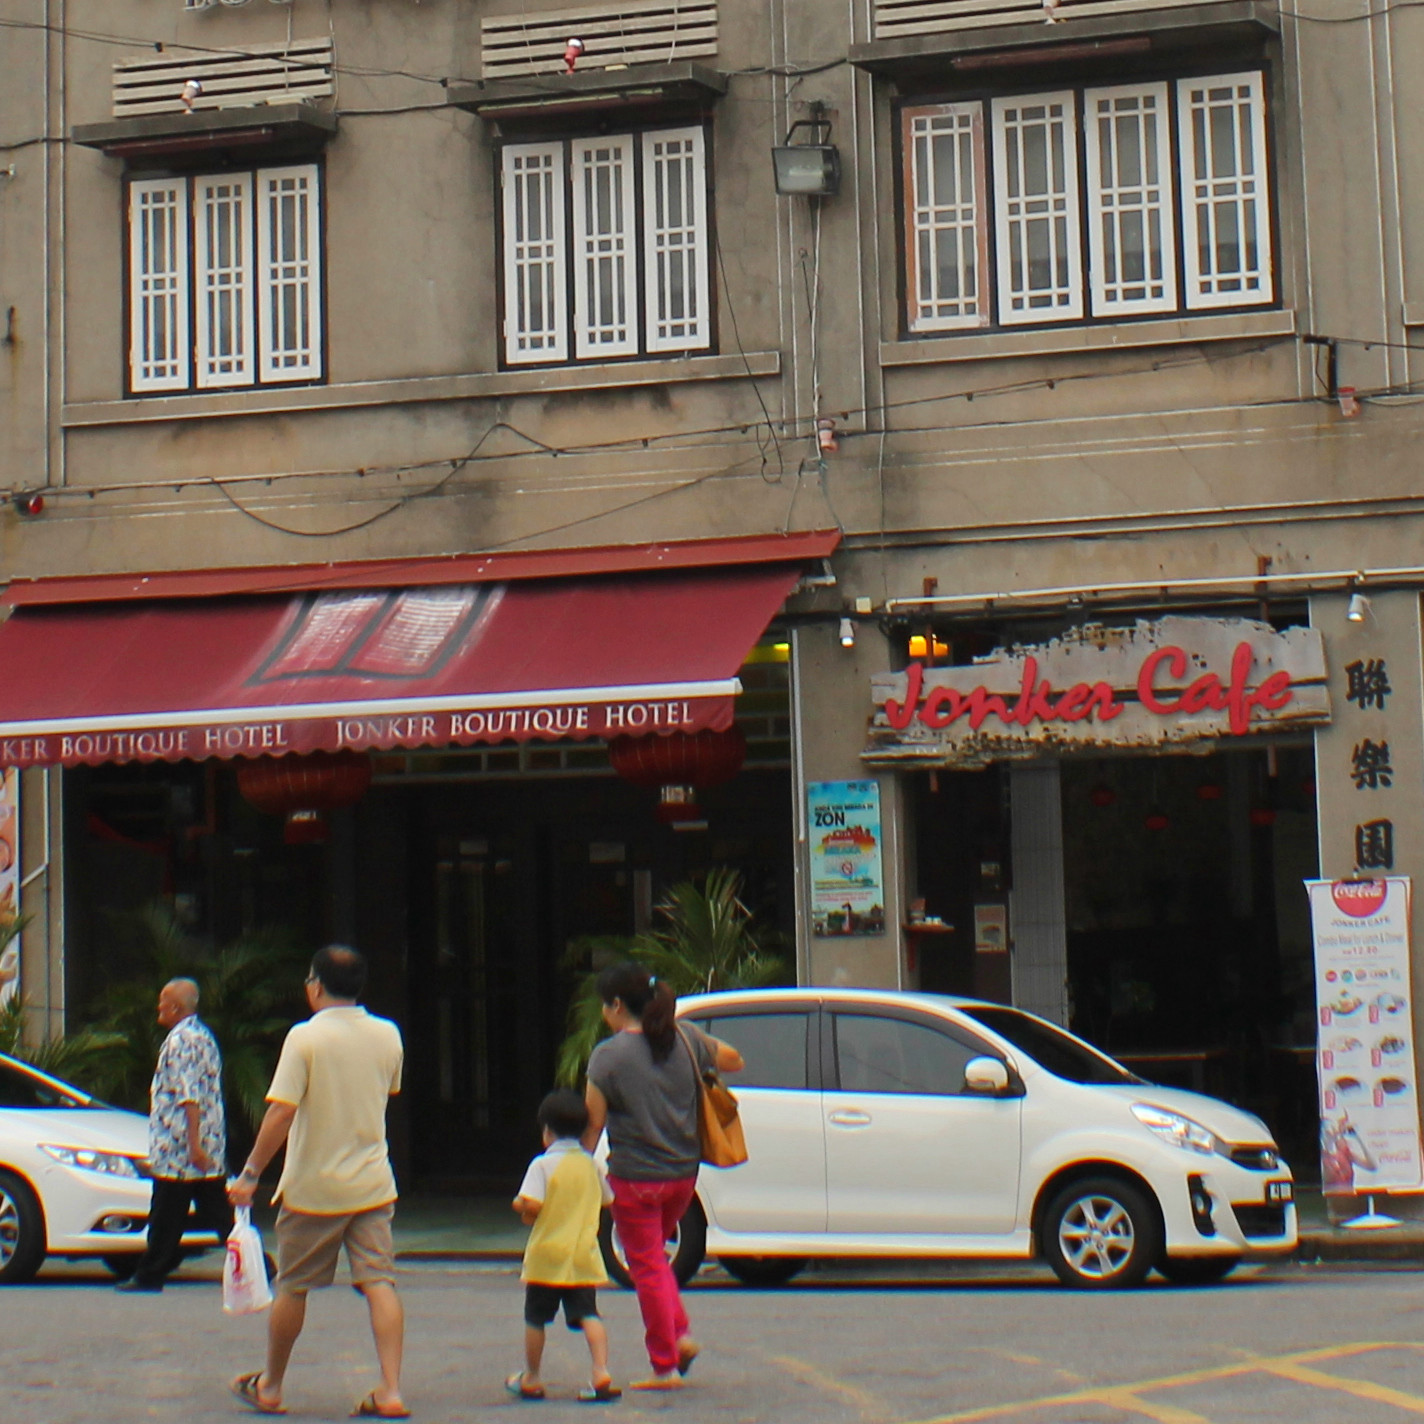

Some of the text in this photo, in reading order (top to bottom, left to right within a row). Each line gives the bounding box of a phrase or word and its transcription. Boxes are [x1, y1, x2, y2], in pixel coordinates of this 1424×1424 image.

[885, 642, 1293, 734] Jonker Cafe
[60, 731, 188, 763] BOUTIQUE
[204, 722, 288, 751] HOTEL
[336, 701, 694, 746] JONKER BOUTIQUE HOTEL
[815, 811, 845, 827] ZON
[1368, 916, 1391, 925] CAFE
